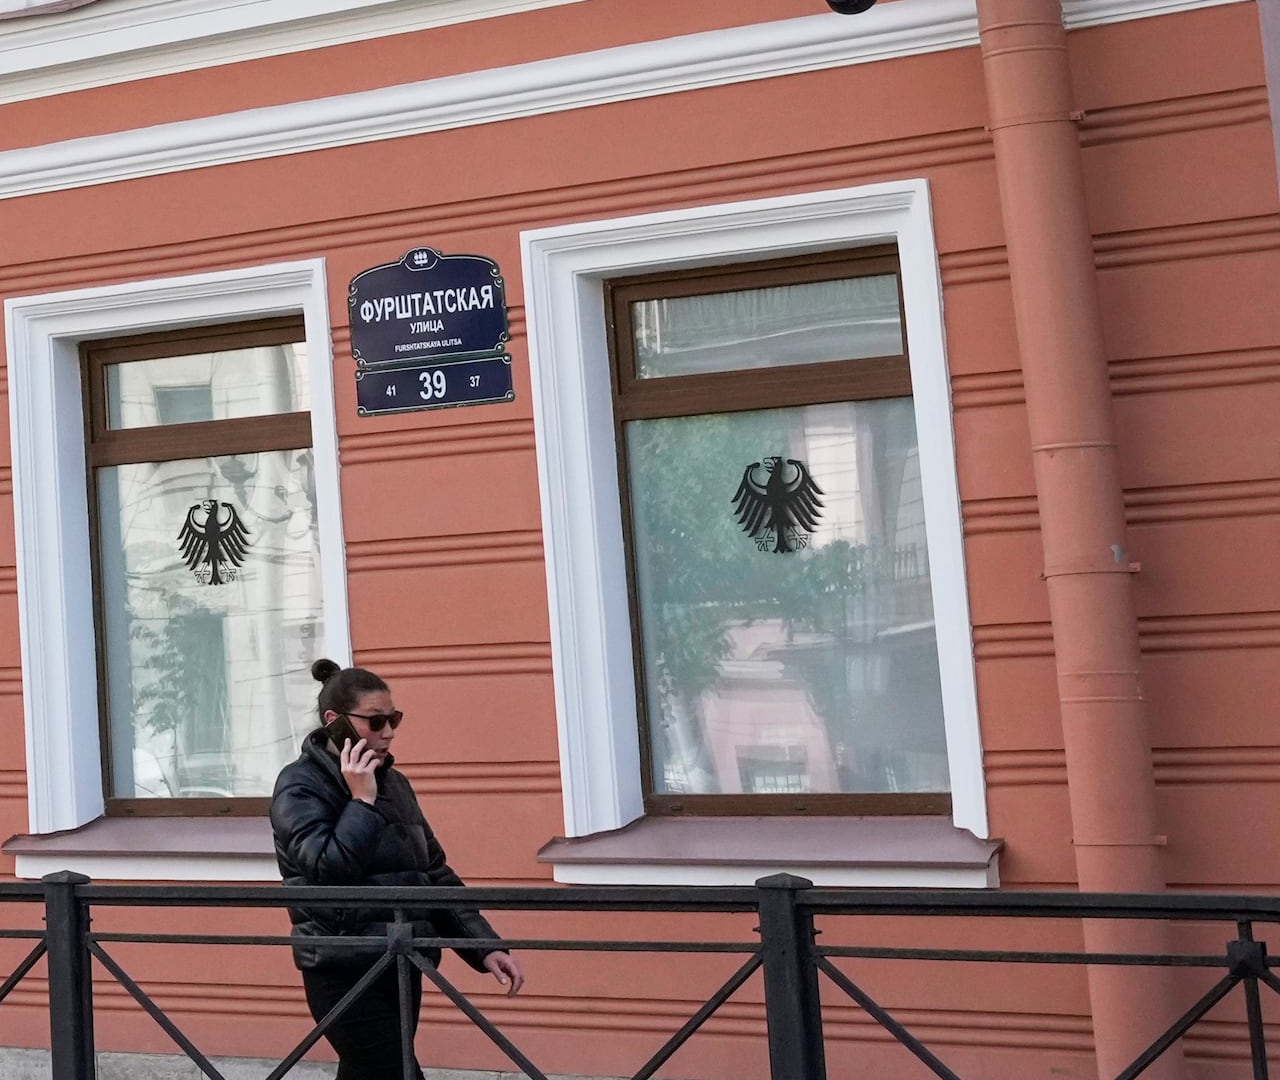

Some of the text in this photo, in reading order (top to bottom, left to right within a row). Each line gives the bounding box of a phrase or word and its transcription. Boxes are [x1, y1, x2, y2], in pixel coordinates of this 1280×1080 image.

[360, 285, 494, 322] ФУРШТАТСКАЯ
[410, 319, 444, 335] УЛИЦА
[386, 370, 481, 400] 41 39 37
